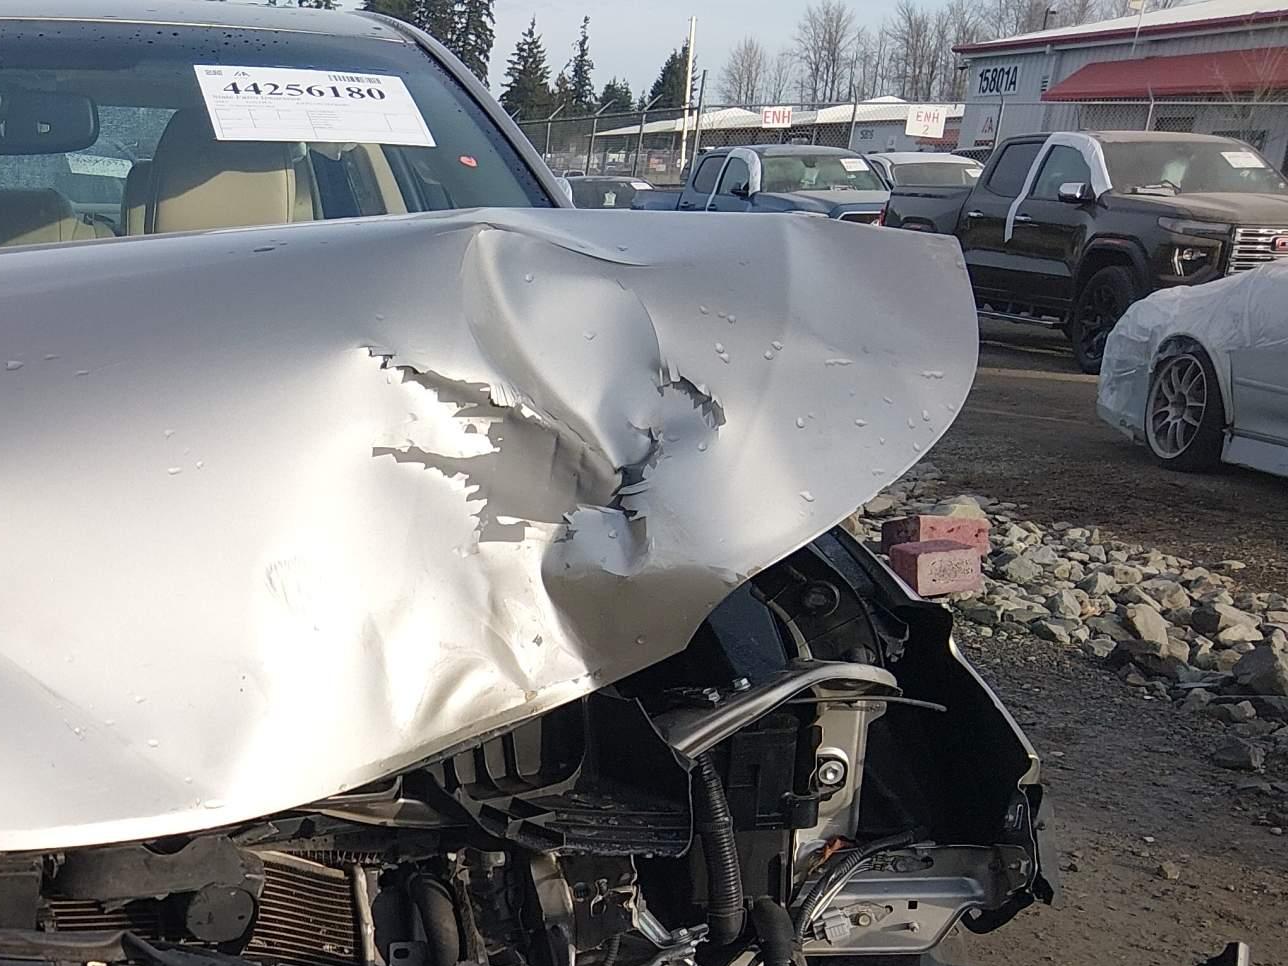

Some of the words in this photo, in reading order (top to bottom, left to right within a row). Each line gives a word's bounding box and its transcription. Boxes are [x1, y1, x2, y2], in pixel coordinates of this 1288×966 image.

[978, 65, 1018, 94] 15801A
[223, 81, 386, 100] 44256180
[763, 110, 792, 125] ENH
[916, 111, 940, 123] ENH
[922, 125, 930, 136] 2
